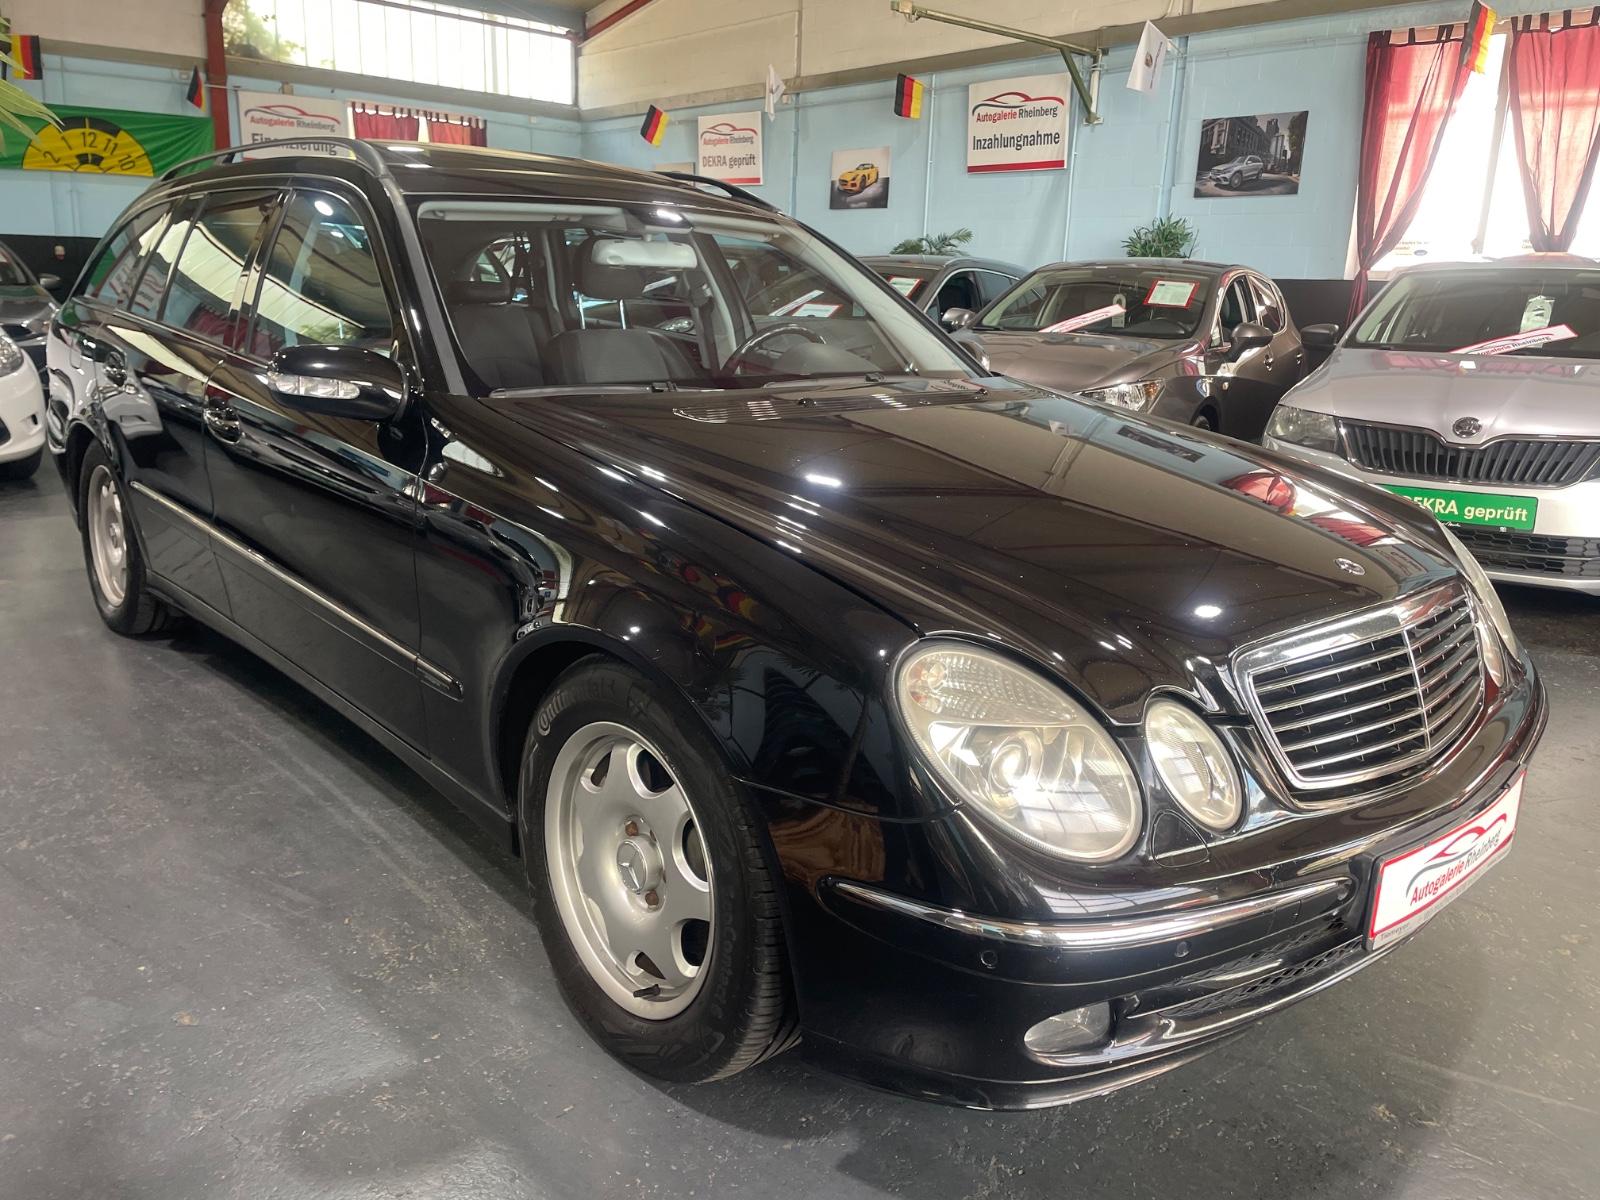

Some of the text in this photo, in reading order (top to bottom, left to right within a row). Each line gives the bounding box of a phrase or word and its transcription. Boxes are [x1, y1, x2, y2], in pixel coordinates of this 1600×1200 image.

[250, 116, 336, 133] Autogalerie Rheinberg
[976, 106, 1058, 123] Autogalerie Rheinberg
[43, 151, 61, 164] 2
[81, 131, 98, 148] 12
[103, 138, 118, 155] 11
[118, 154, 136, 171] 10
[251, 133, 337, 156] Finzierung
[973, 130, 1060, 151] Inzahlungnahme
[702, 153, 756, 169] DEKRA geprüft
[1403, 496, 1528, 522] KRA geprüft
[1410, 828, 1502, 906] Autogalerie Rheinberg
